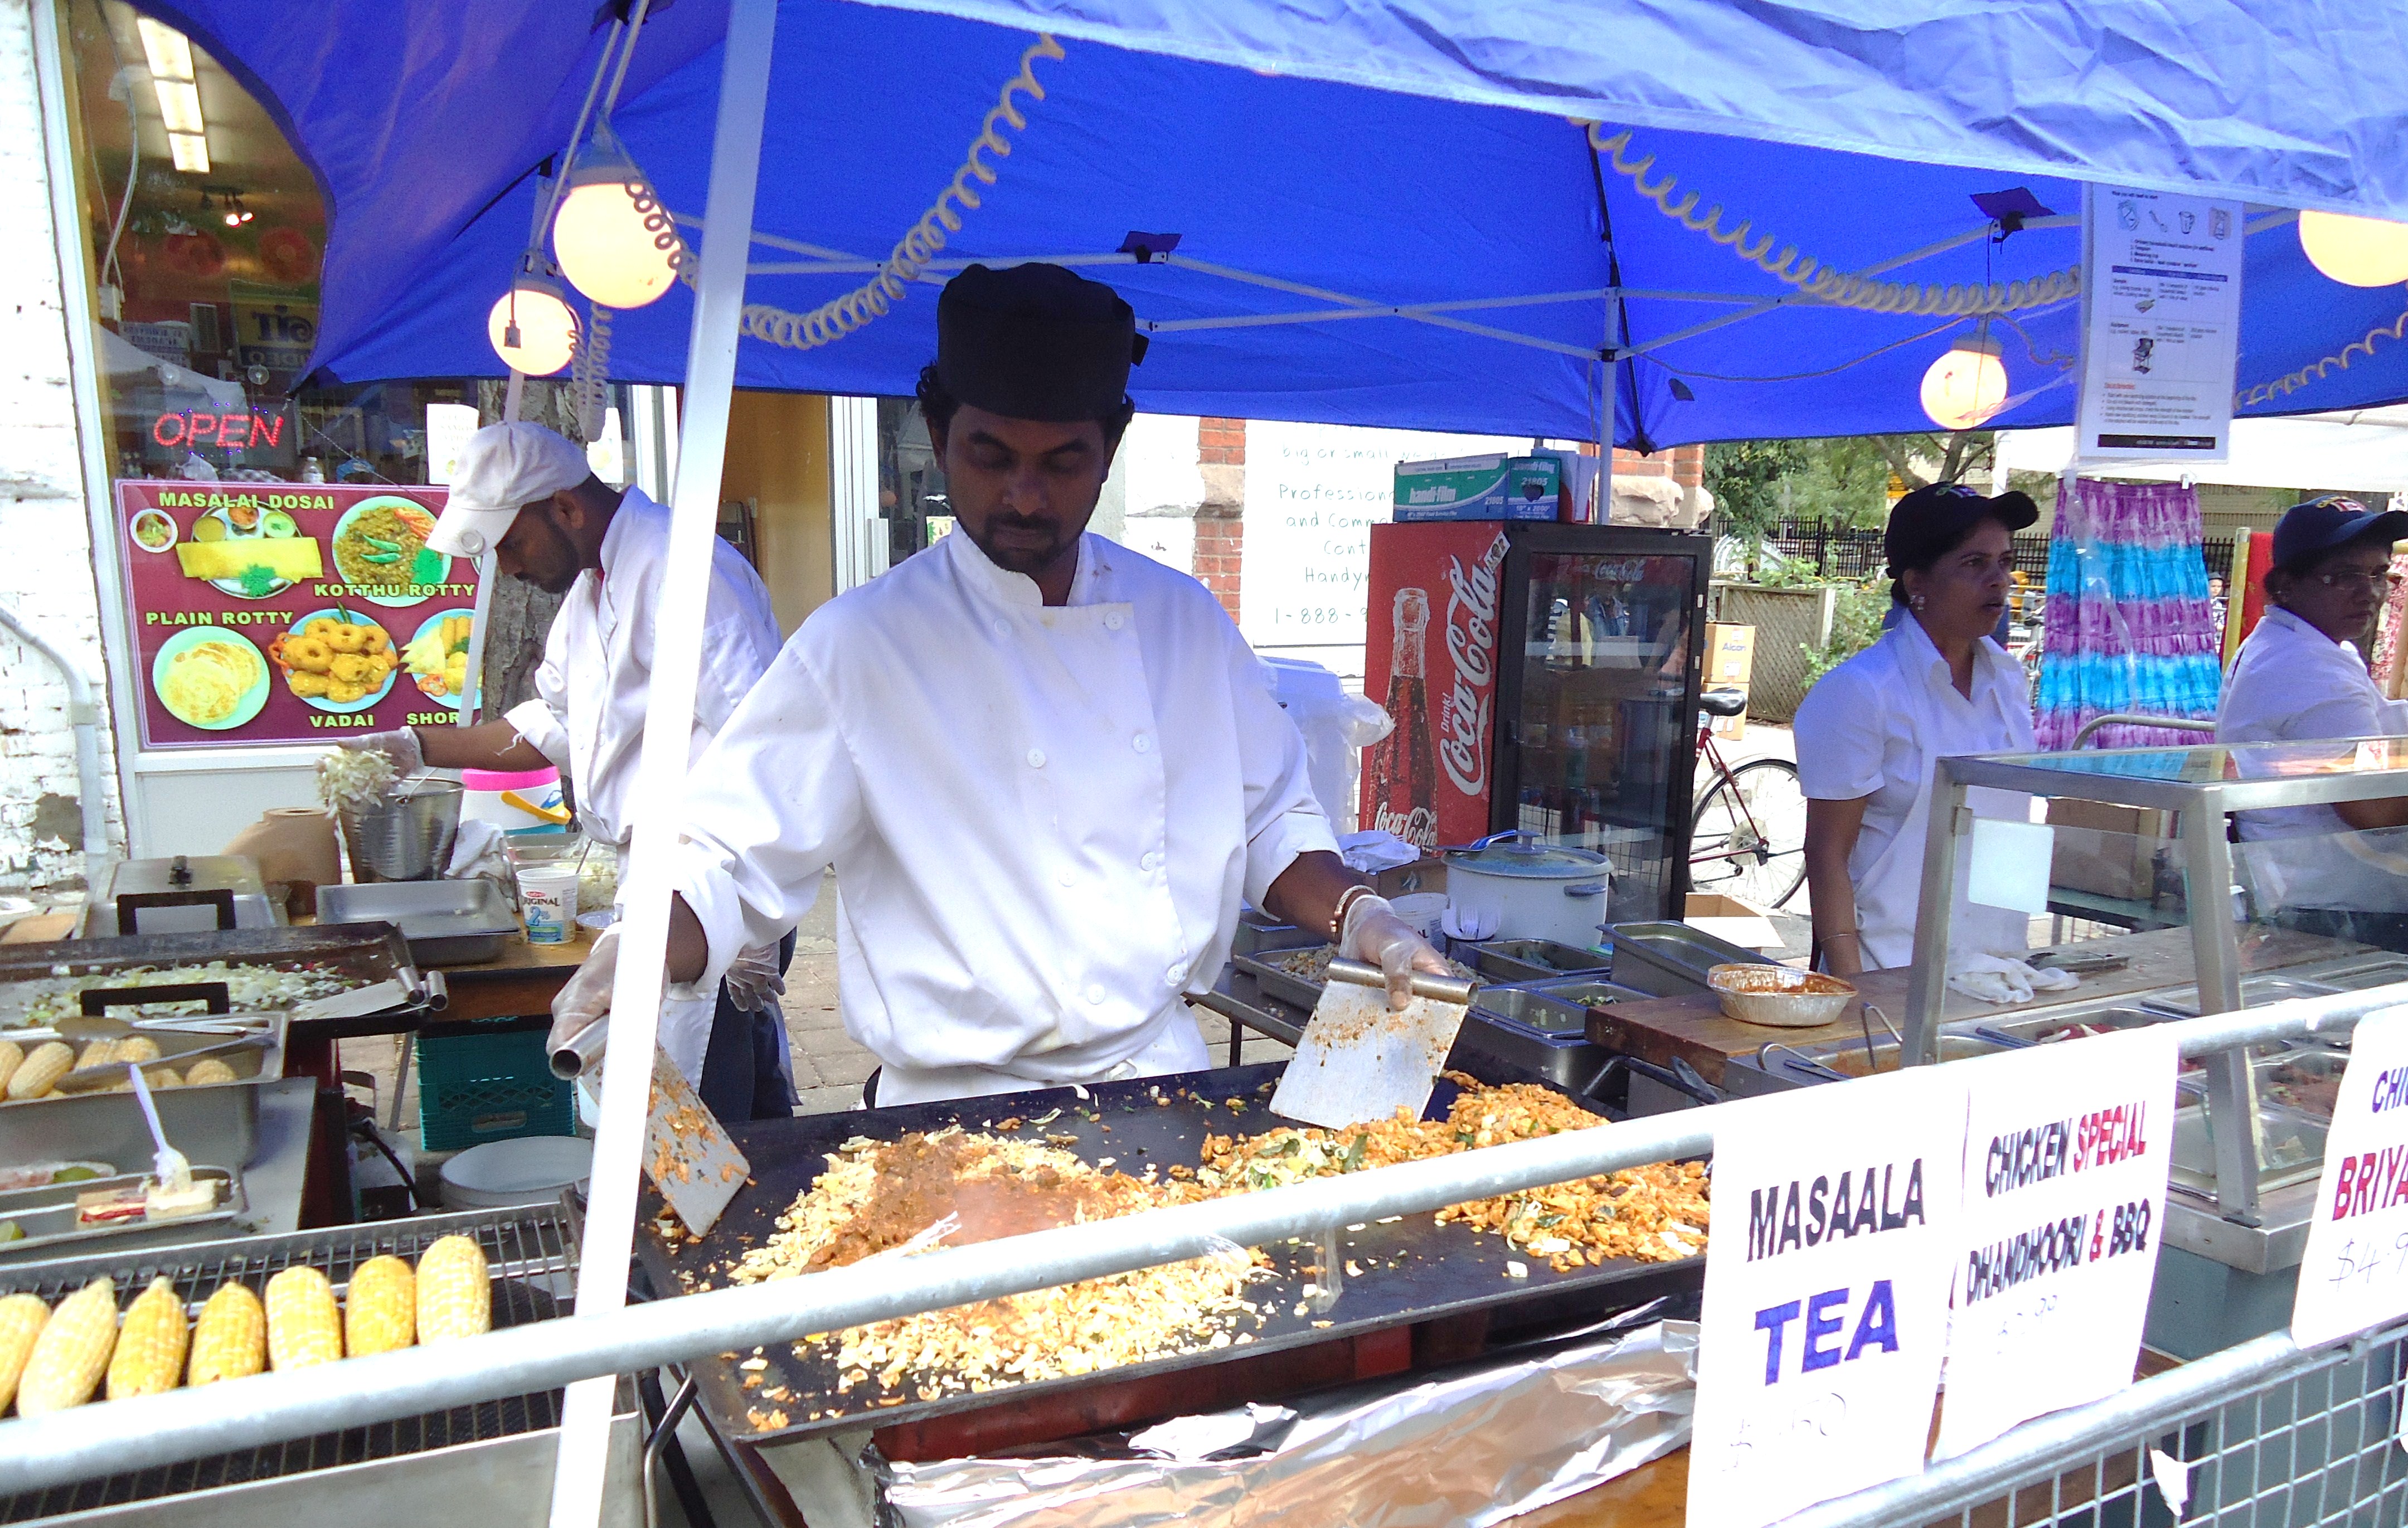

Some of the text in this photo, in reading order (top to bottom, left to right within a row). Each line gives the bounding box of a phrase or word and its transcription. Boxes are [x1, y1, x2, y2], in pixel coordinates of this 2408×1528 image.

[153, 413, 283, 448] OPEN
[1283, 441, 1309, 465] big
[1318, 449, 1335, 458] or
[159, 493, 334, 510] MASALAI DOSAI
[1409, 486, 1457, 503] handi-film
[1286, 511, 1319, 527] and
[314, 583, 475, 597] KOTTHU ROTTY
[146, 611, 294, 625] PLAIN ROTTY
[1439, 554, 1497, 797] Coca-Cola
[309, 714, 374, 727] VADAI
[1440, 692, 1450, 734] Drink!
[1375, 801, 1438, 848] Coca-Cola
[523, 897, 560, 906] RIGINAL
[529, 906, 551, 926] 2%
[1985, 1100, 2147, 1199] CHICKEN SPECIAL
[1747, 1158, 1925, 1263] MASAALA
[1967, 1197, 2151, 1306] DHANDHOORI & BBQ
[1755, 1279, 1900, 1386] TEA
